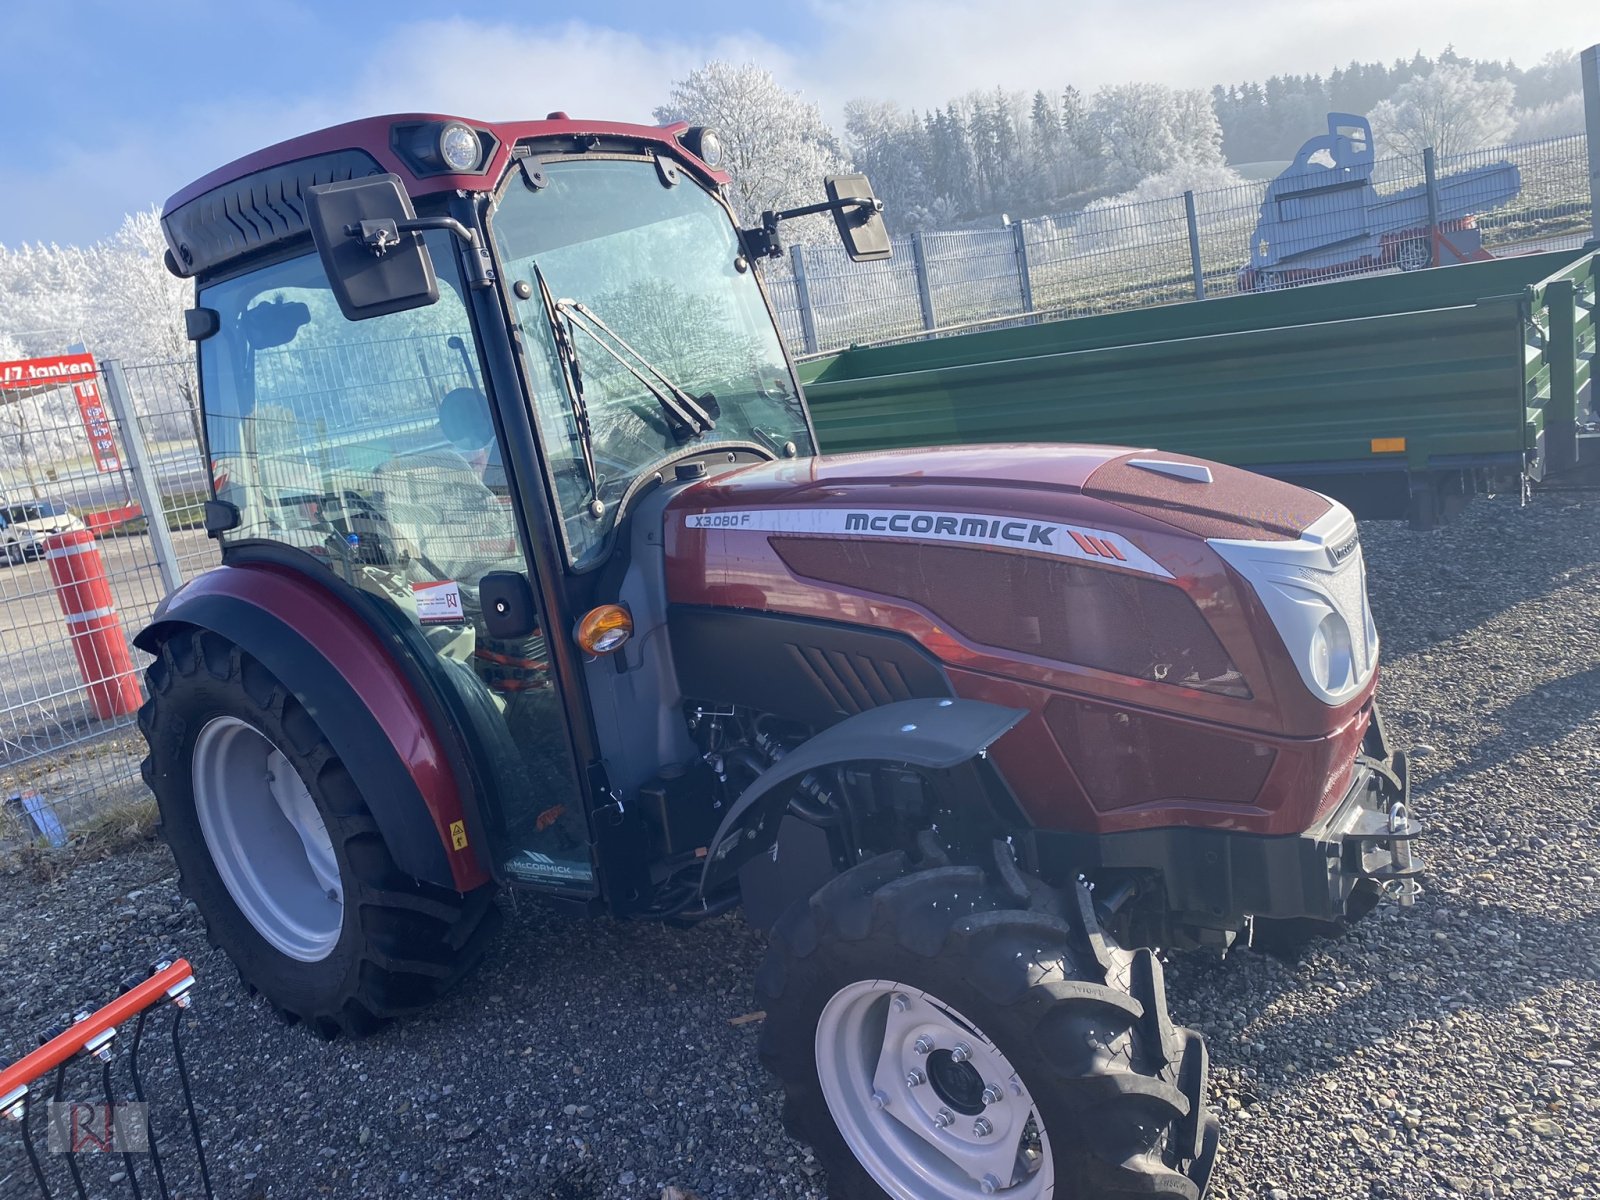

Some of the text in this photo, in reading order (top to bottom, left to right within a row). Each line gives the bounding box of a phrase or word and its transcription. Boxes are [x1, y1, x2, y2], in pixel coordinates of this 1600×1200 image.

[28, 361, 93, 379] tanken
[695, 515, 750, 527] X3.080 F
